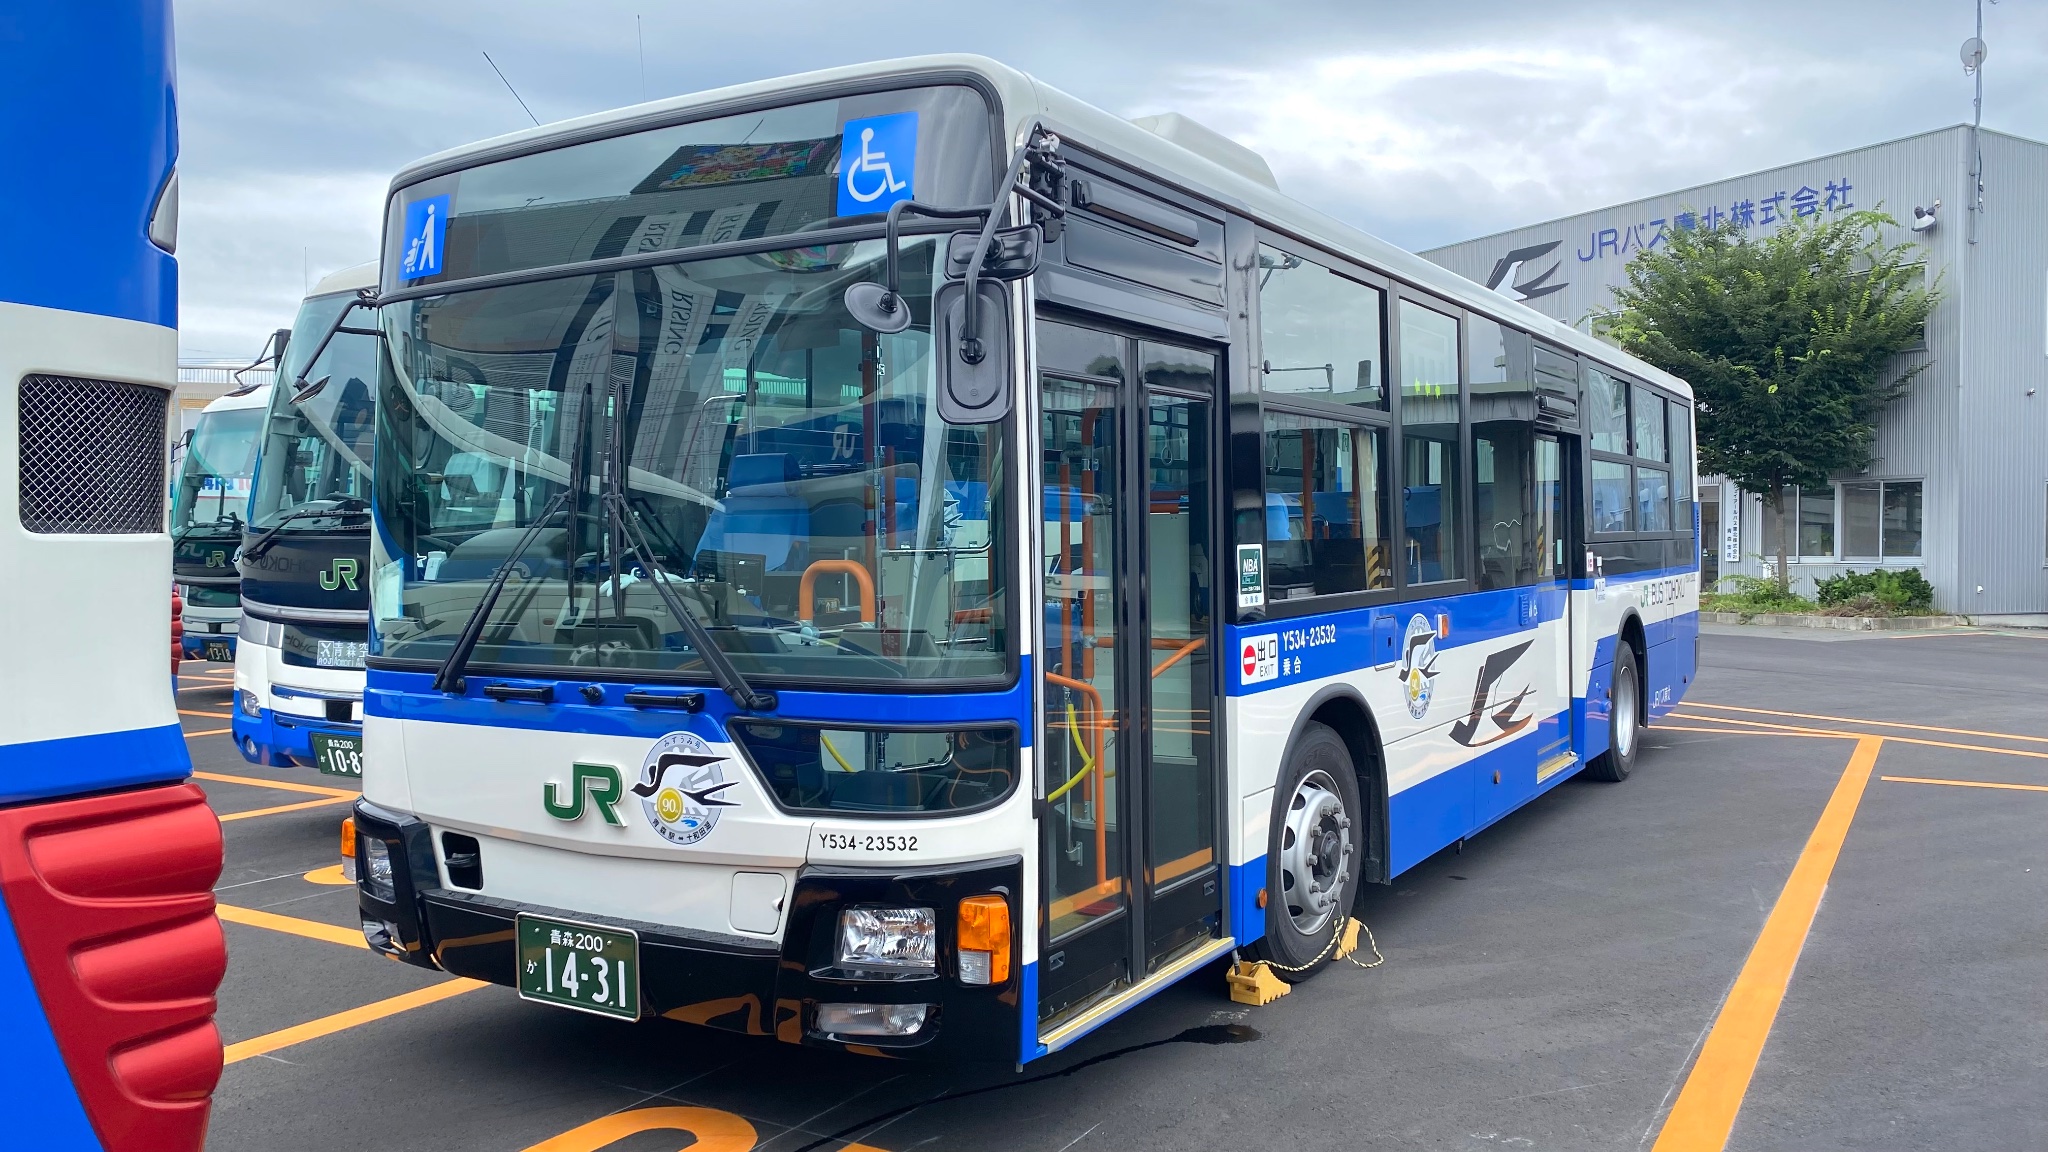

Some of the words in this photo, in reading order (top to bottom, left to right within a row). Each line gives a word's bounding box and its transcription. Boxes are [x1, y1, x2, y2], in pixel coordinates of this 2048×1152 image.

[205, 550, 226, 568] JR
[1242, 558, 1259, 573] NBA
[320, 558, 358, 591] JR
[1282, 623, 1336, 652] Y534-23532
[1257, 639, 1277, 662] 出口
[1259, 663, 1275, 677] EXIT
[1283, 655, 1302, 676] 乗合
[663, 735, 701, 750] みずうみ号
[326, 748, 363, 774] 10-8
[543, 761, 626, 828] JR
[662, 798, 676, 813] 90
[819, 833, 919, 852] Y534-23532
[526, 959, 538, 975] か
[545, 947, 626, 1008] 14-31
